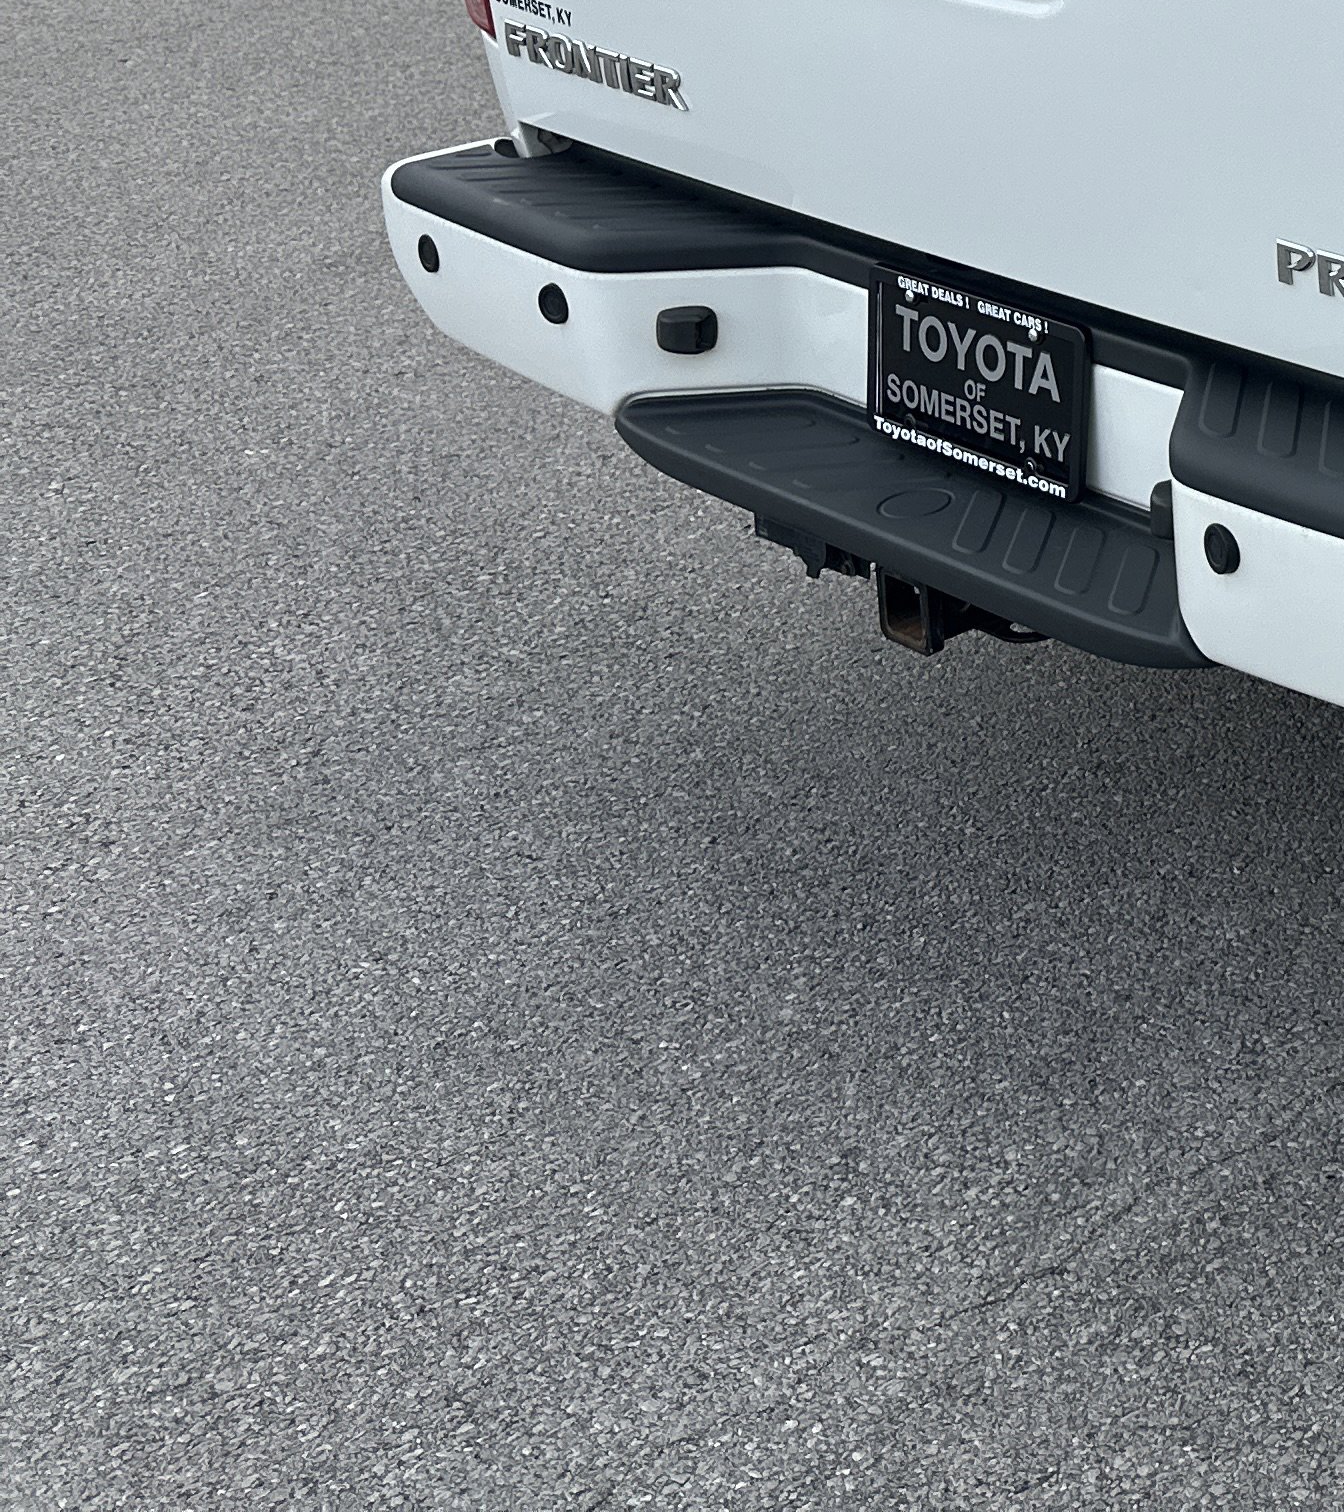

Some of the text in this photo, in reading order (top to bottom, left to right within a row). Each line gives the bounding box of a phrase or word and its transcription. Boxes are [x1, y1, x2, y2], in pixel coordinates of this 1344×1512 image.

[504, 18, 690, 112] FRONTIER
[897, 275, 929, 297] GREAT
[977, 300, 1011, 322] GREAT
[895, 303, 1061, 404] TOYOTA
[964, 379, 986, 402] OF
[873, 414, 1066, 499] ToyotaofSomerset.com
[886, 373, 1071, 463] SOMERSET, KY
